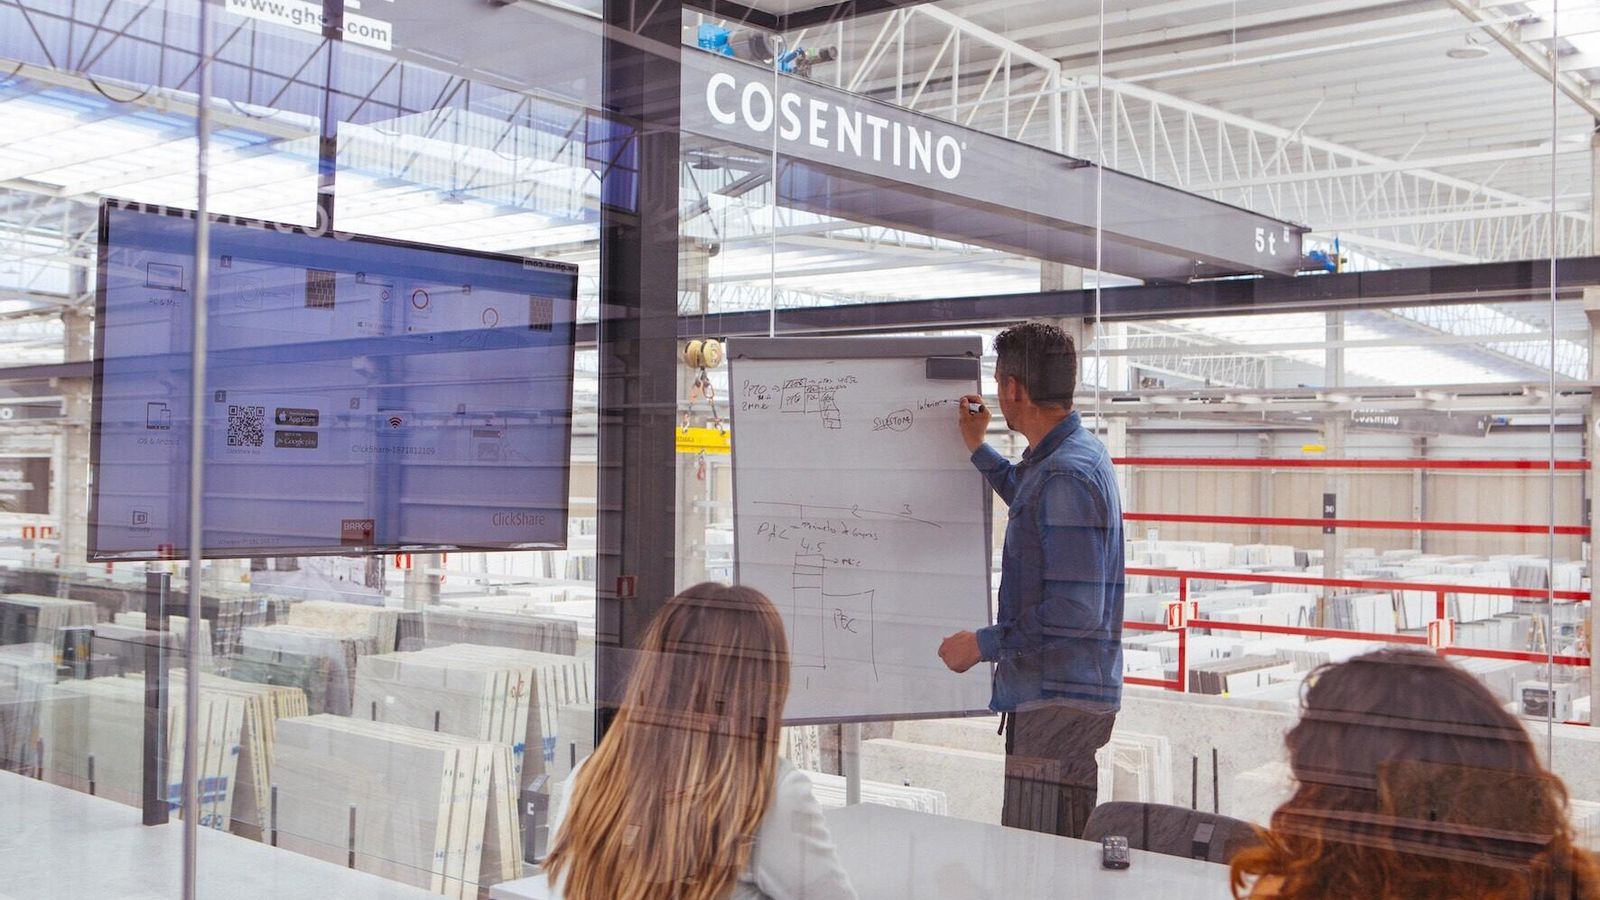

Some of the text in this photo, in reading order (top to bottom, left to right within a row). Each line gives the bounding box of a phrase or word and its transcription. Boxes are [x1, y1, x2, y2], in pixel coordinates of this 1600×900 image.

[706, 72, 962, 179] COSENTINO
[1255, 227, 1277, 256] 5 t
[492, 512, 545, 527] ClickShare
